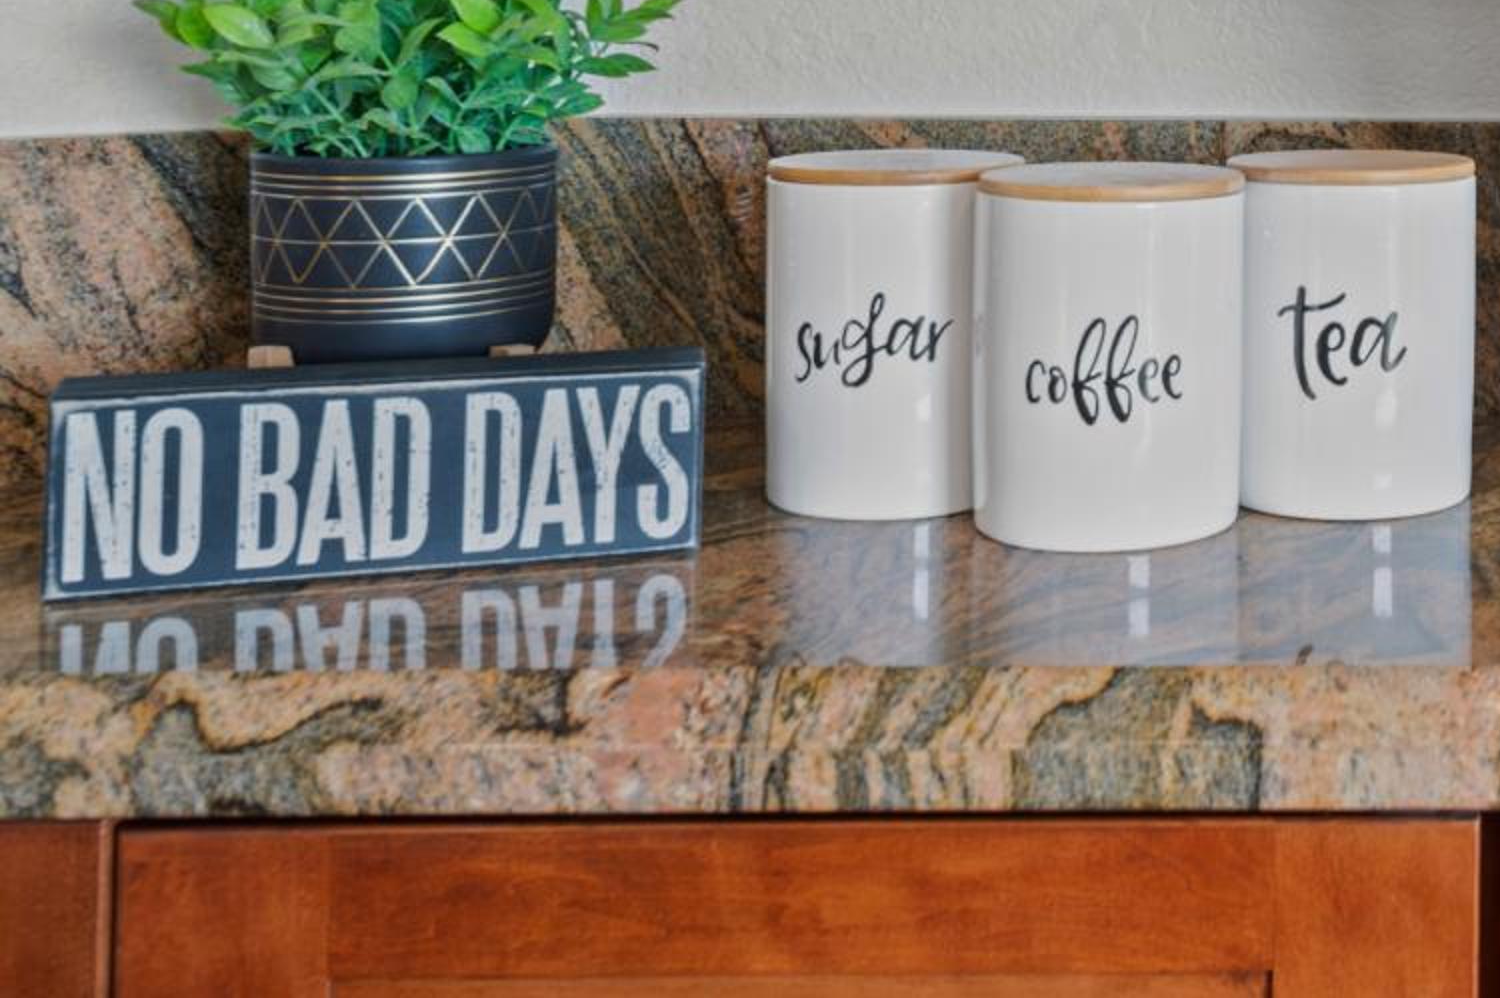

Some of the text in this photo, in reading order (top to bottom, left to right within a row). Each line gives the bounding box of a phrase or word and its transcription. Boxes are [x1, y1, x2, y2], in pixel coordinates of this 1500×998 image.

[796, 291, 954, 388] sugar
[1024, 314, 1184, 427] coffee
[1278, 285, 1408, 401] tea
[62, 383, 691, 583] NO BAD DAYS
